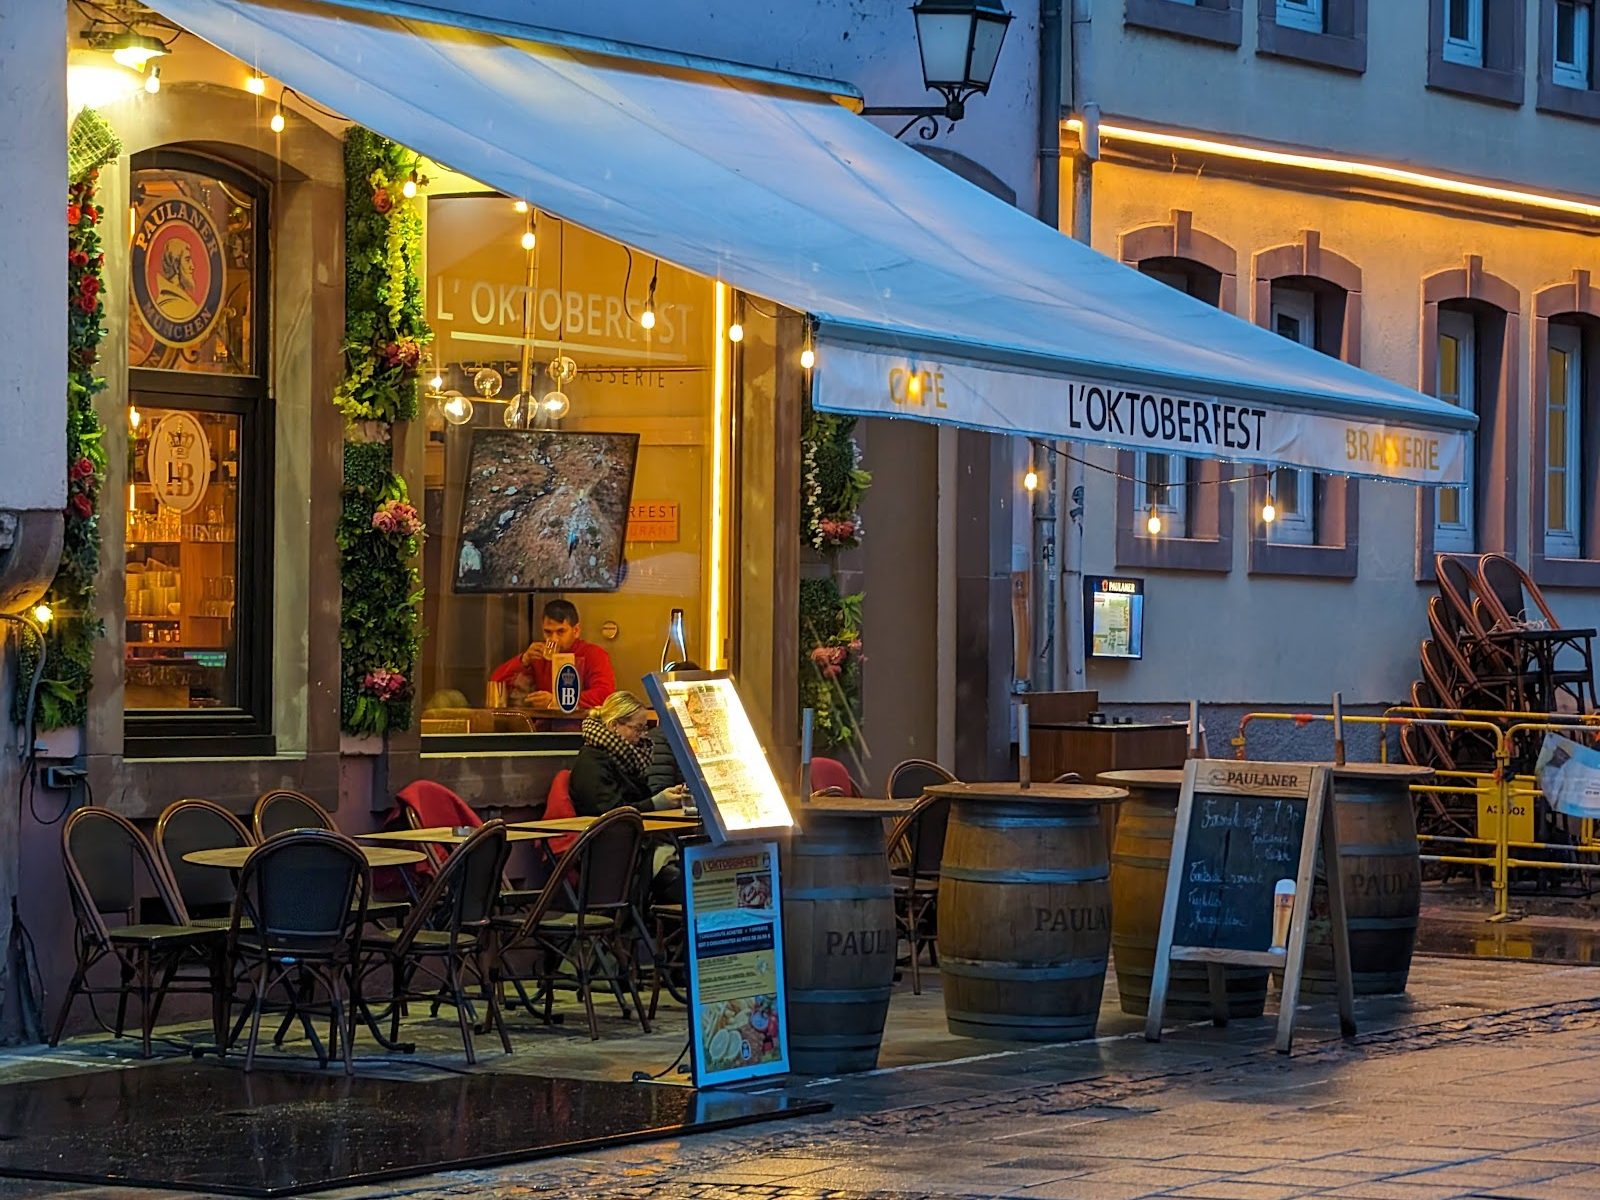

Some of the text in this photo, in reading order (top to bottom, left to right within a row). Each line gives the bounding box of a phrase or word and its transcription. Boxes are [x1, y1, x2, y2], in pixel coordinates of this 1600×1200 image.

[135, 202, 219, 256] PAULANER
[1069, 383, 1267, 452] L'OKTOBERFEST
[1108, 581, 1136, 593] PAULANER
[561, 687, 575, 706] HB
[1226, 771, 1298, 788] PAULANER
